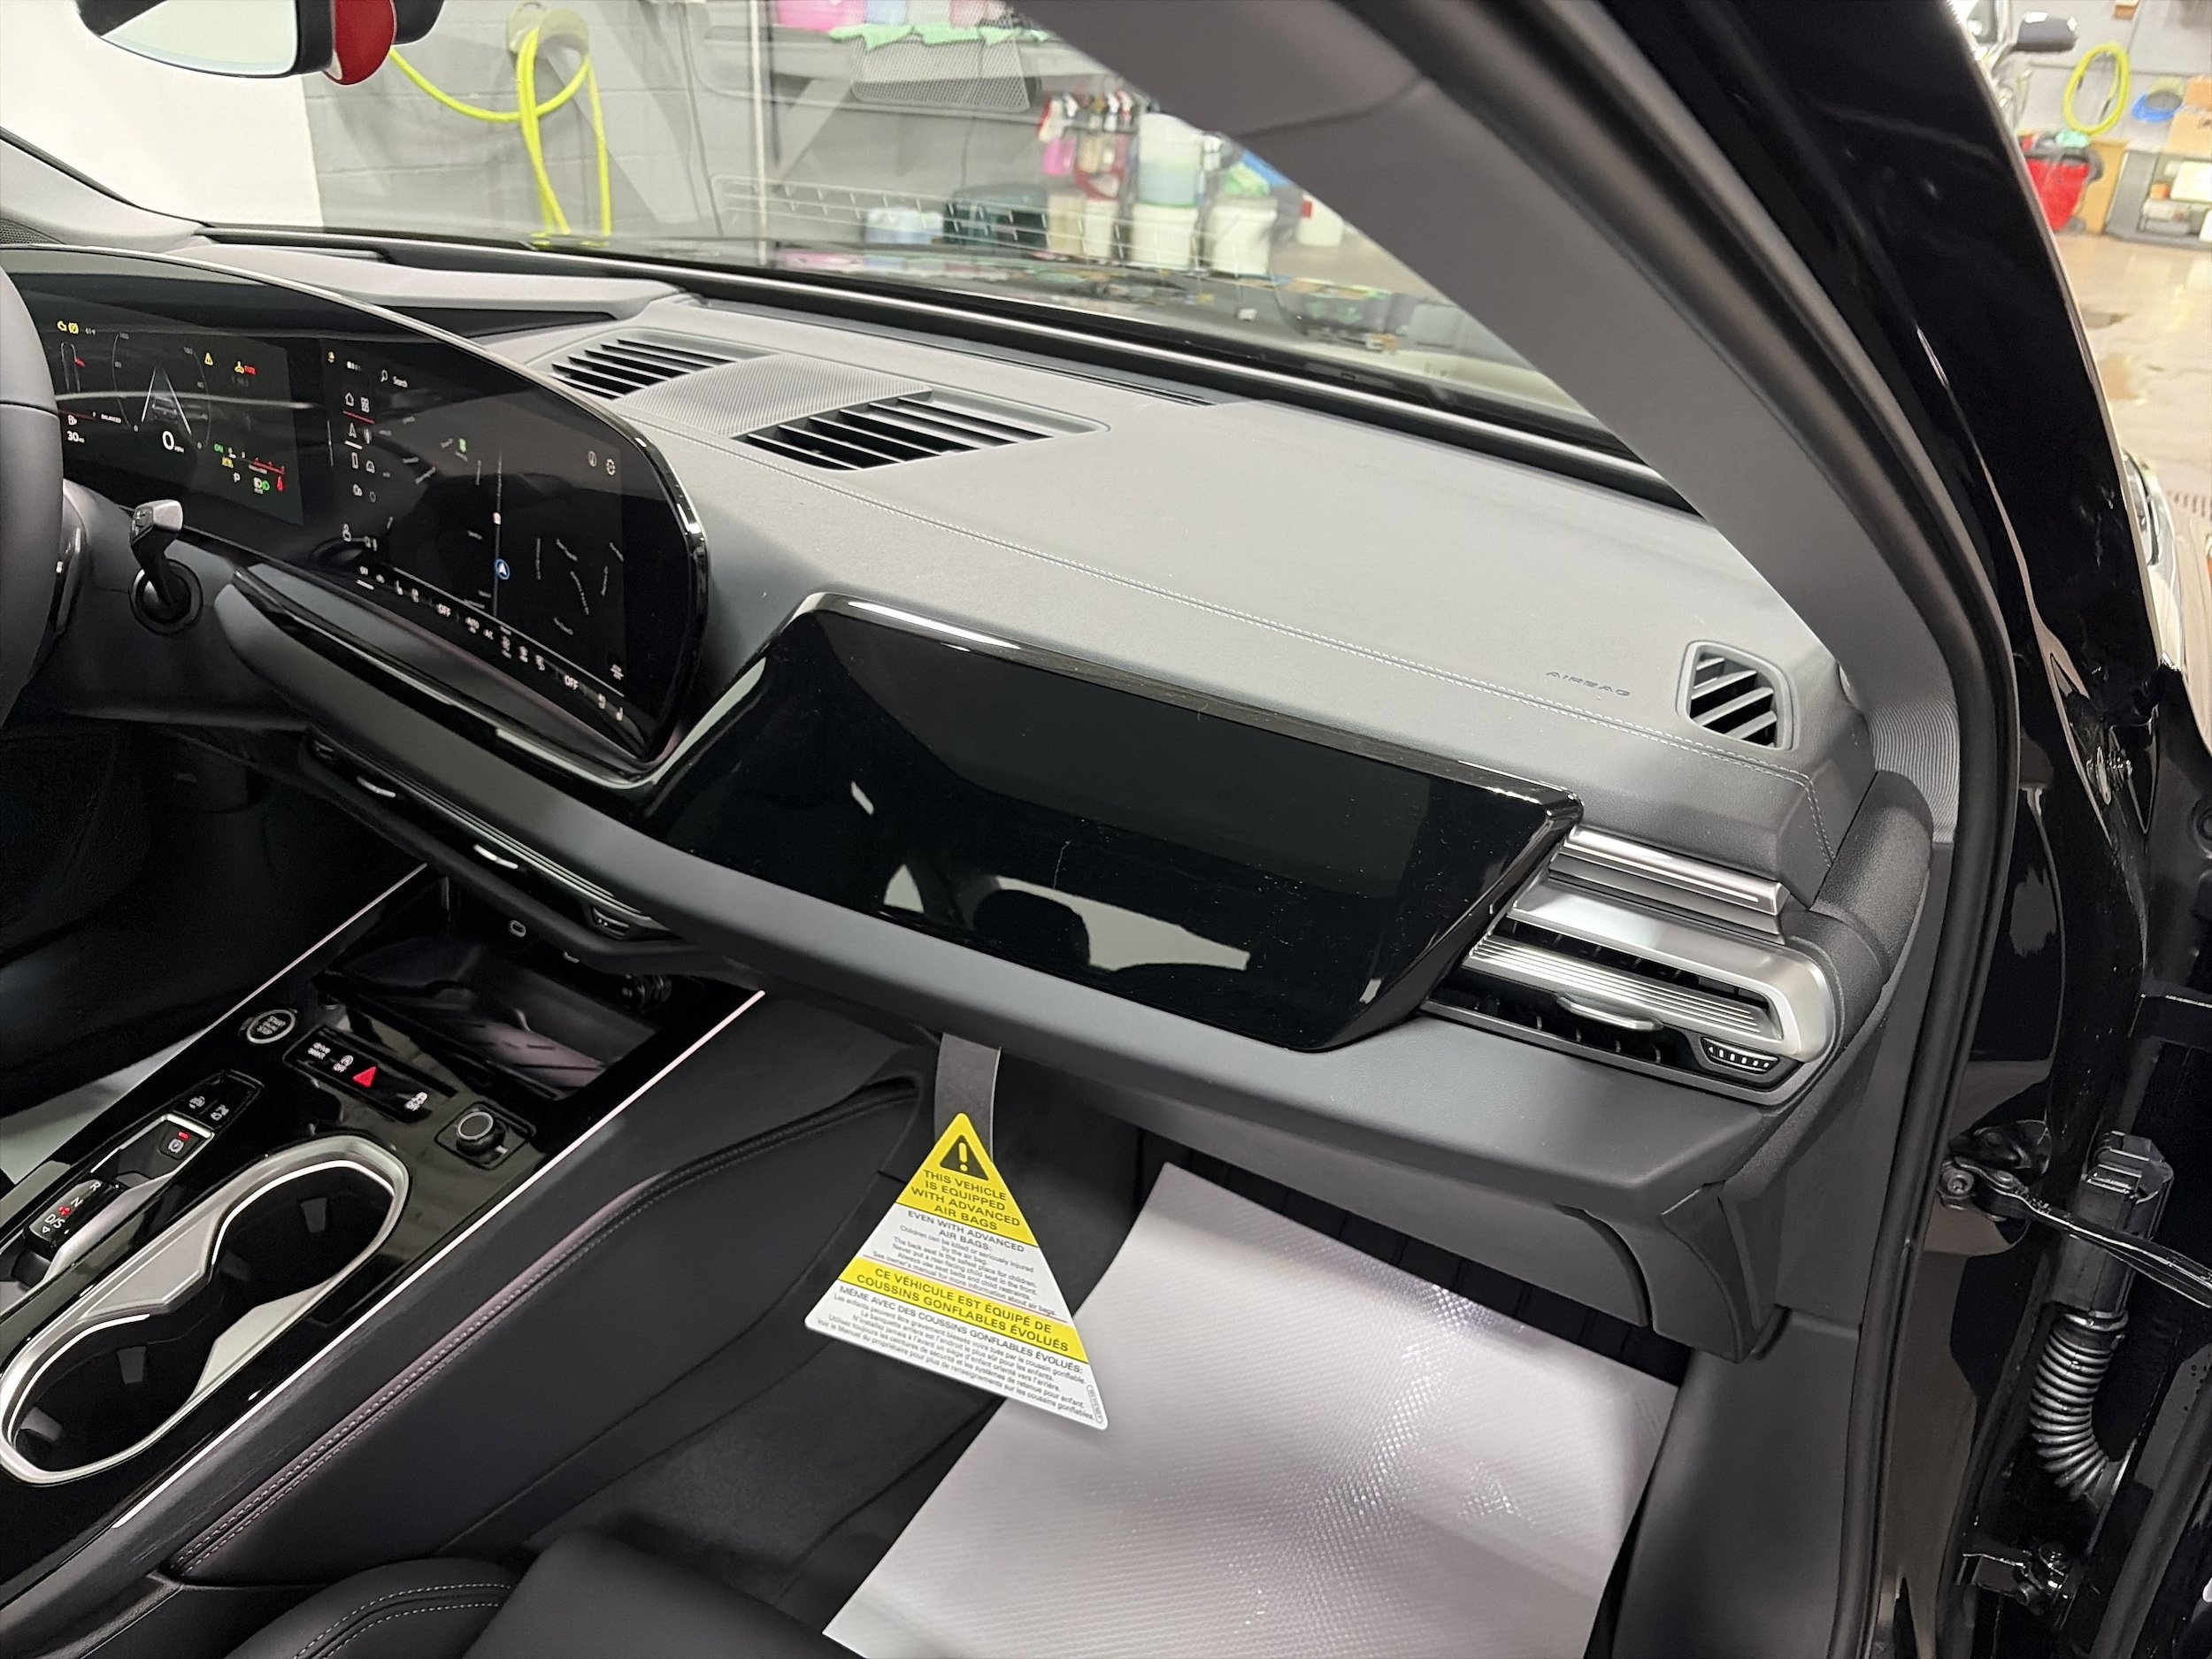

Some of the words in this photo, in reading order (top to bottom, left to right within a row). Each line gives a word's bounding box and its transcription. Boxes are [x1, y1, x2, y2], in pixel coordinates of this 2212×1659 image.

[162, 431, 174, 450] 0
[564, 674, 579, 690] OFF
[1546, 672, 1630, 696] AIRBAG
[89, 1181, 102, 1192] R
[924, 1168, 950, 1184] THIS
[954, 1177, 1006, 1201] VEHICLE
[926, 1179, 936, 1190] IS
[941, 1185, 1004, 1211] EQUIPPED
[71, 1197, 83, 1208] N
[911, 1186, 944, 1203] WITH
[949, 1197, 1019, 1226] ADVANCED
[45, 1214, 65, 1229] D/S
[933, 1203, 956, 1217] AIR
[961, 1211, 996, 1231] BAGS
[900, 1225, 926, 1239] Children
[951, 1240, 968, 1251] killed
[908, 1210, 933, 1224] EVEN
[937, 1218, 964, 1233] WITH
[967, 1228, 1024, 1253] ADVANCED
[939, 1228, 956, 1240] AIR
[960, 1235, 991, 1251] BAGS:
[894, 1236, 905, 1245] The
[907, 1240, 921, 1250] back
[924, 1247, 936, 1256] seat
[978, 1263, 995, 1275] place
[941, 1244, 949, 1253] by
[951, 1248, 961, 1256] the
[913, 1249, 923, 1258] put
[984, 1273, 997, 1282] seat
[935, 1264, 949, 1273] seat
[981, 1279, 997, 1289] child
[856, 1272, 919, 1302] COUSSINS
[924, 1294, 1005, 1333] GONFLABLES
[1010, 1322, 1068, 1353] ÉVOLUÉS
[875, 1267, 890, 1280] CE
[894, 1271, 953, 1302] VÉHICULE
[957, 1294, 980, 1310] EST
[984, 1302, 1030, 1326] ÉQUIPÉ
[1034, 1319, 1051, 1333] DE
[871, 1294, 895, 1310] AVEC
[897, 1304, 915, 1317] DES
[918, 1310, 966, 1335] COUSSINS
[970, 1327, 1032, 1358] GONFLABLES
[1035, 1349, 1083, 1375] ÉVOLUÉS:
